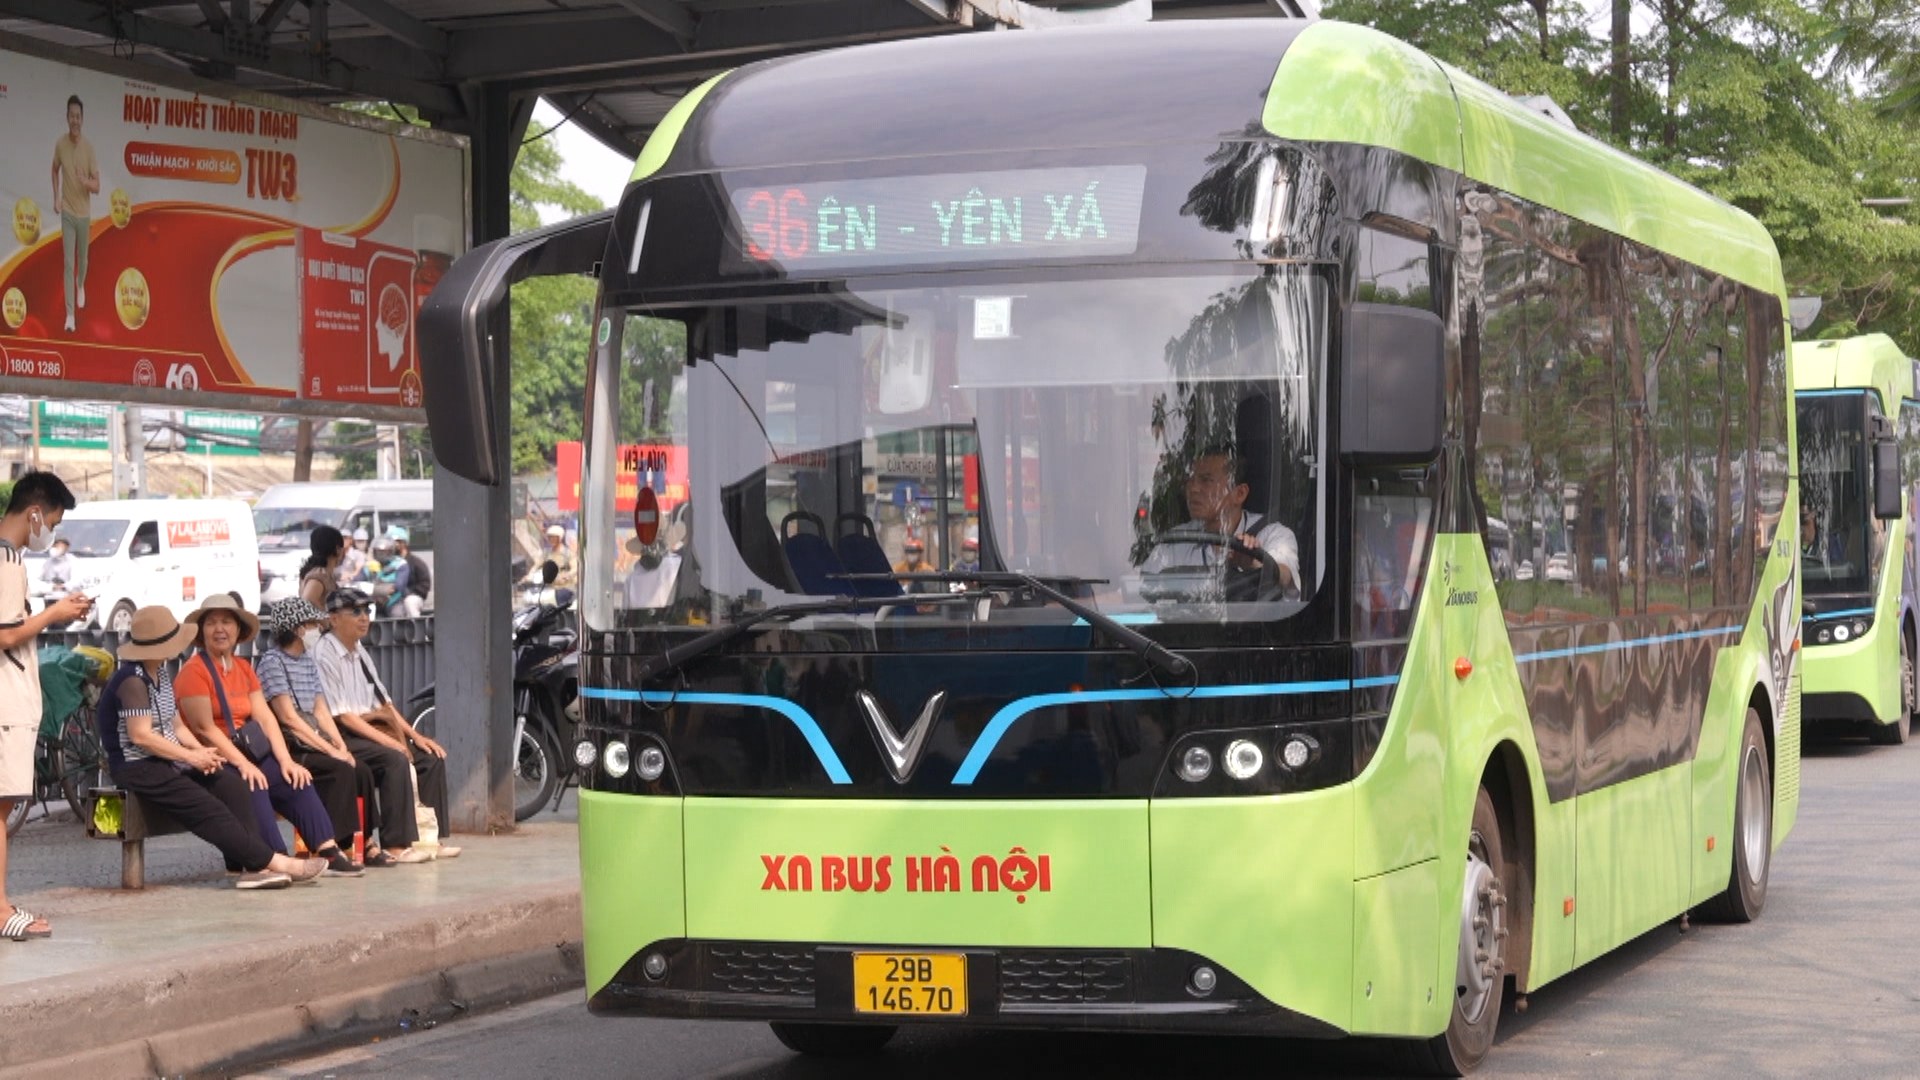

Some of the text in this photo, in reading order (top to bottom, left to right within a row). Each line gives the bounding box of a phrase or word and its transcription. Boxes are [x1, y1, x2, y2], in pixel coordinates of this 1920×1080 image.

[123, 92, 298, 144] HOẠT HUYẾT THÔNG MẠCH
[130, 153, 162, 170] THUẬN
[163, 156, 190, 172] MẠCH
[245, 147, 298, 203] TW3
[746, 188, 810, 261] 36
[931, 186, 1023, 246] YÊN
[1043, 180, 1108, 242] XÁ
[10, 358, 61, 376] 1800 1286
[760, 845, 1051, 904] XN BUS HÀ NỘI
[885, 958, 933, 983] 29B
[868, 986, 953, 1012] 146.70
